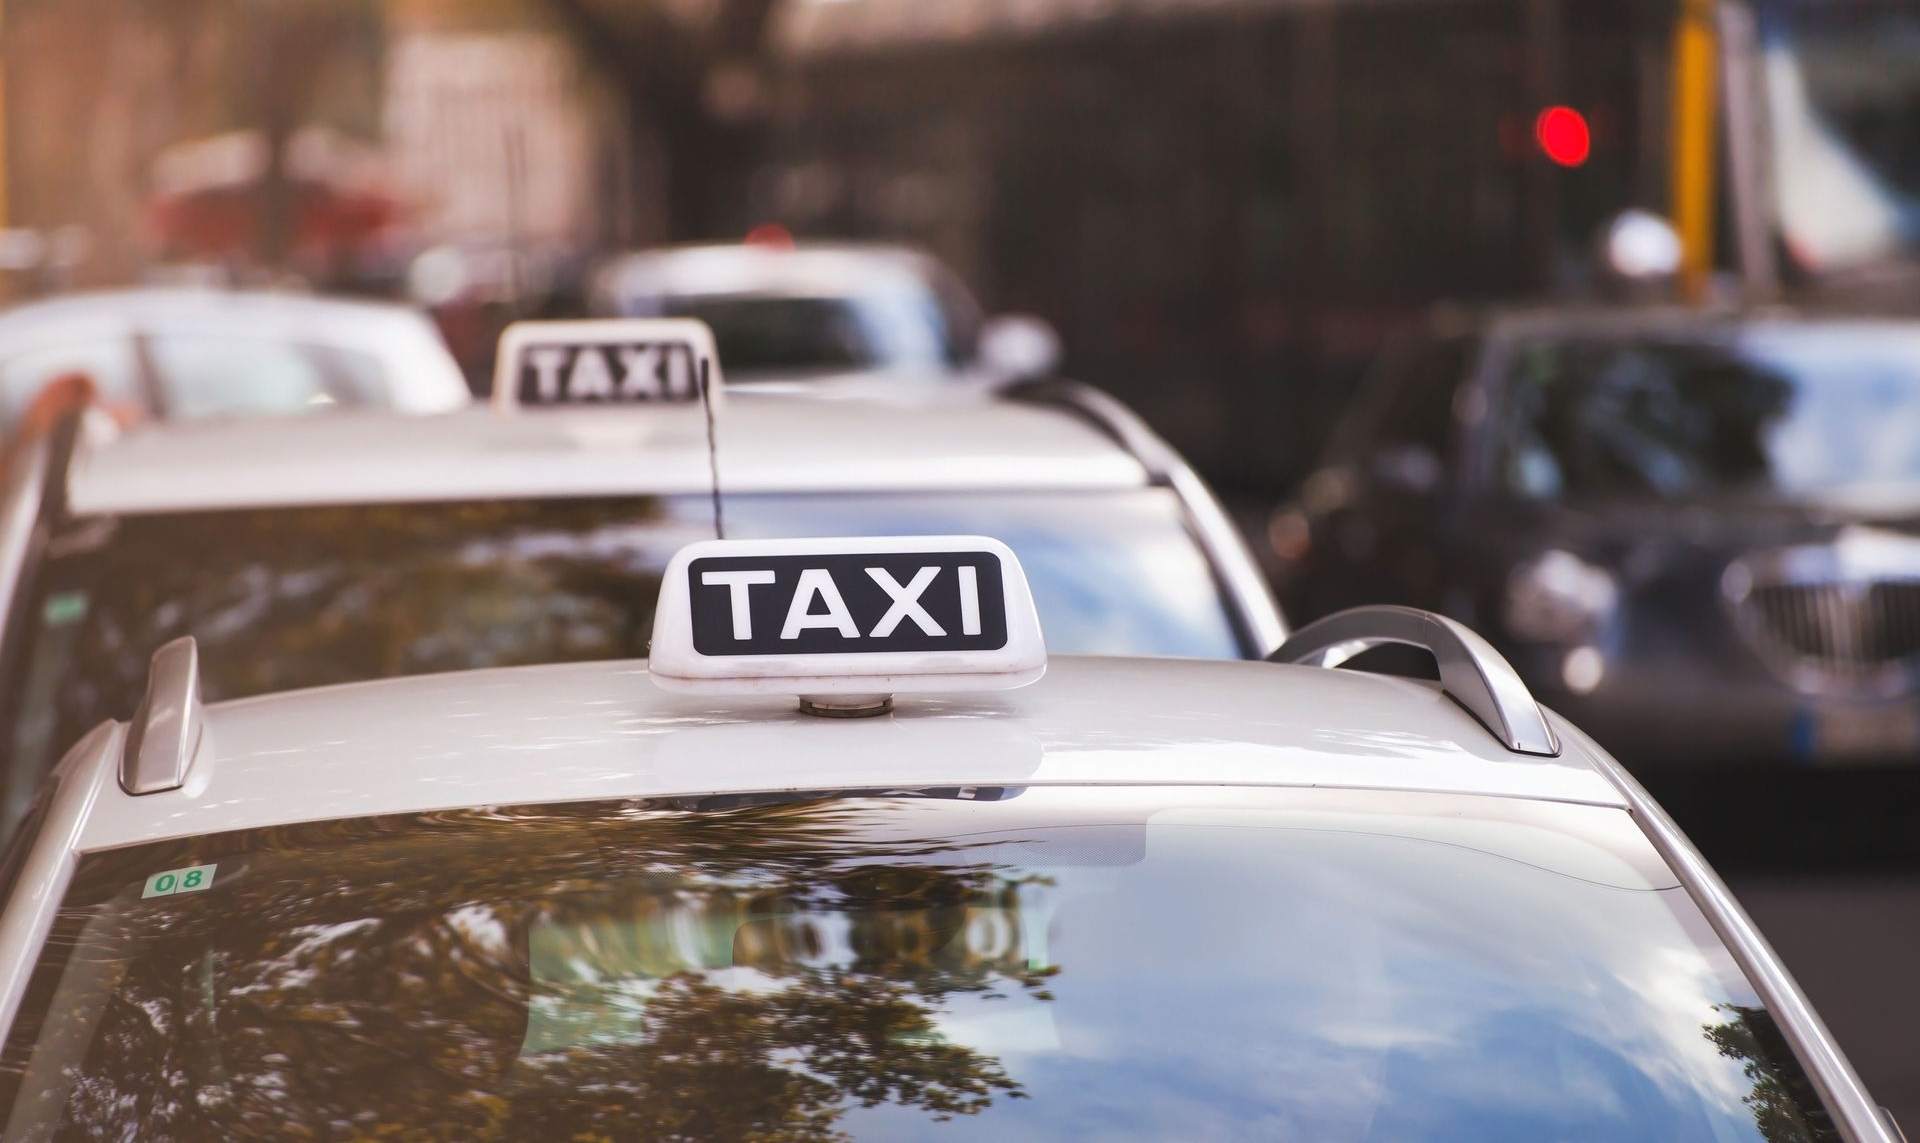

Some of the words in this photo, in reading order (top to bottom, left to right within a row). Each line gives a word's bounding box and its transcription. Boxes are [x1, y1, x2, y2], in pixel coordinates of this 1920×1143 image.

[527, 349, 688, 400] TAXI
[701, 565, 982, 641] TAXI
[154, 870, 203, 892] 08
